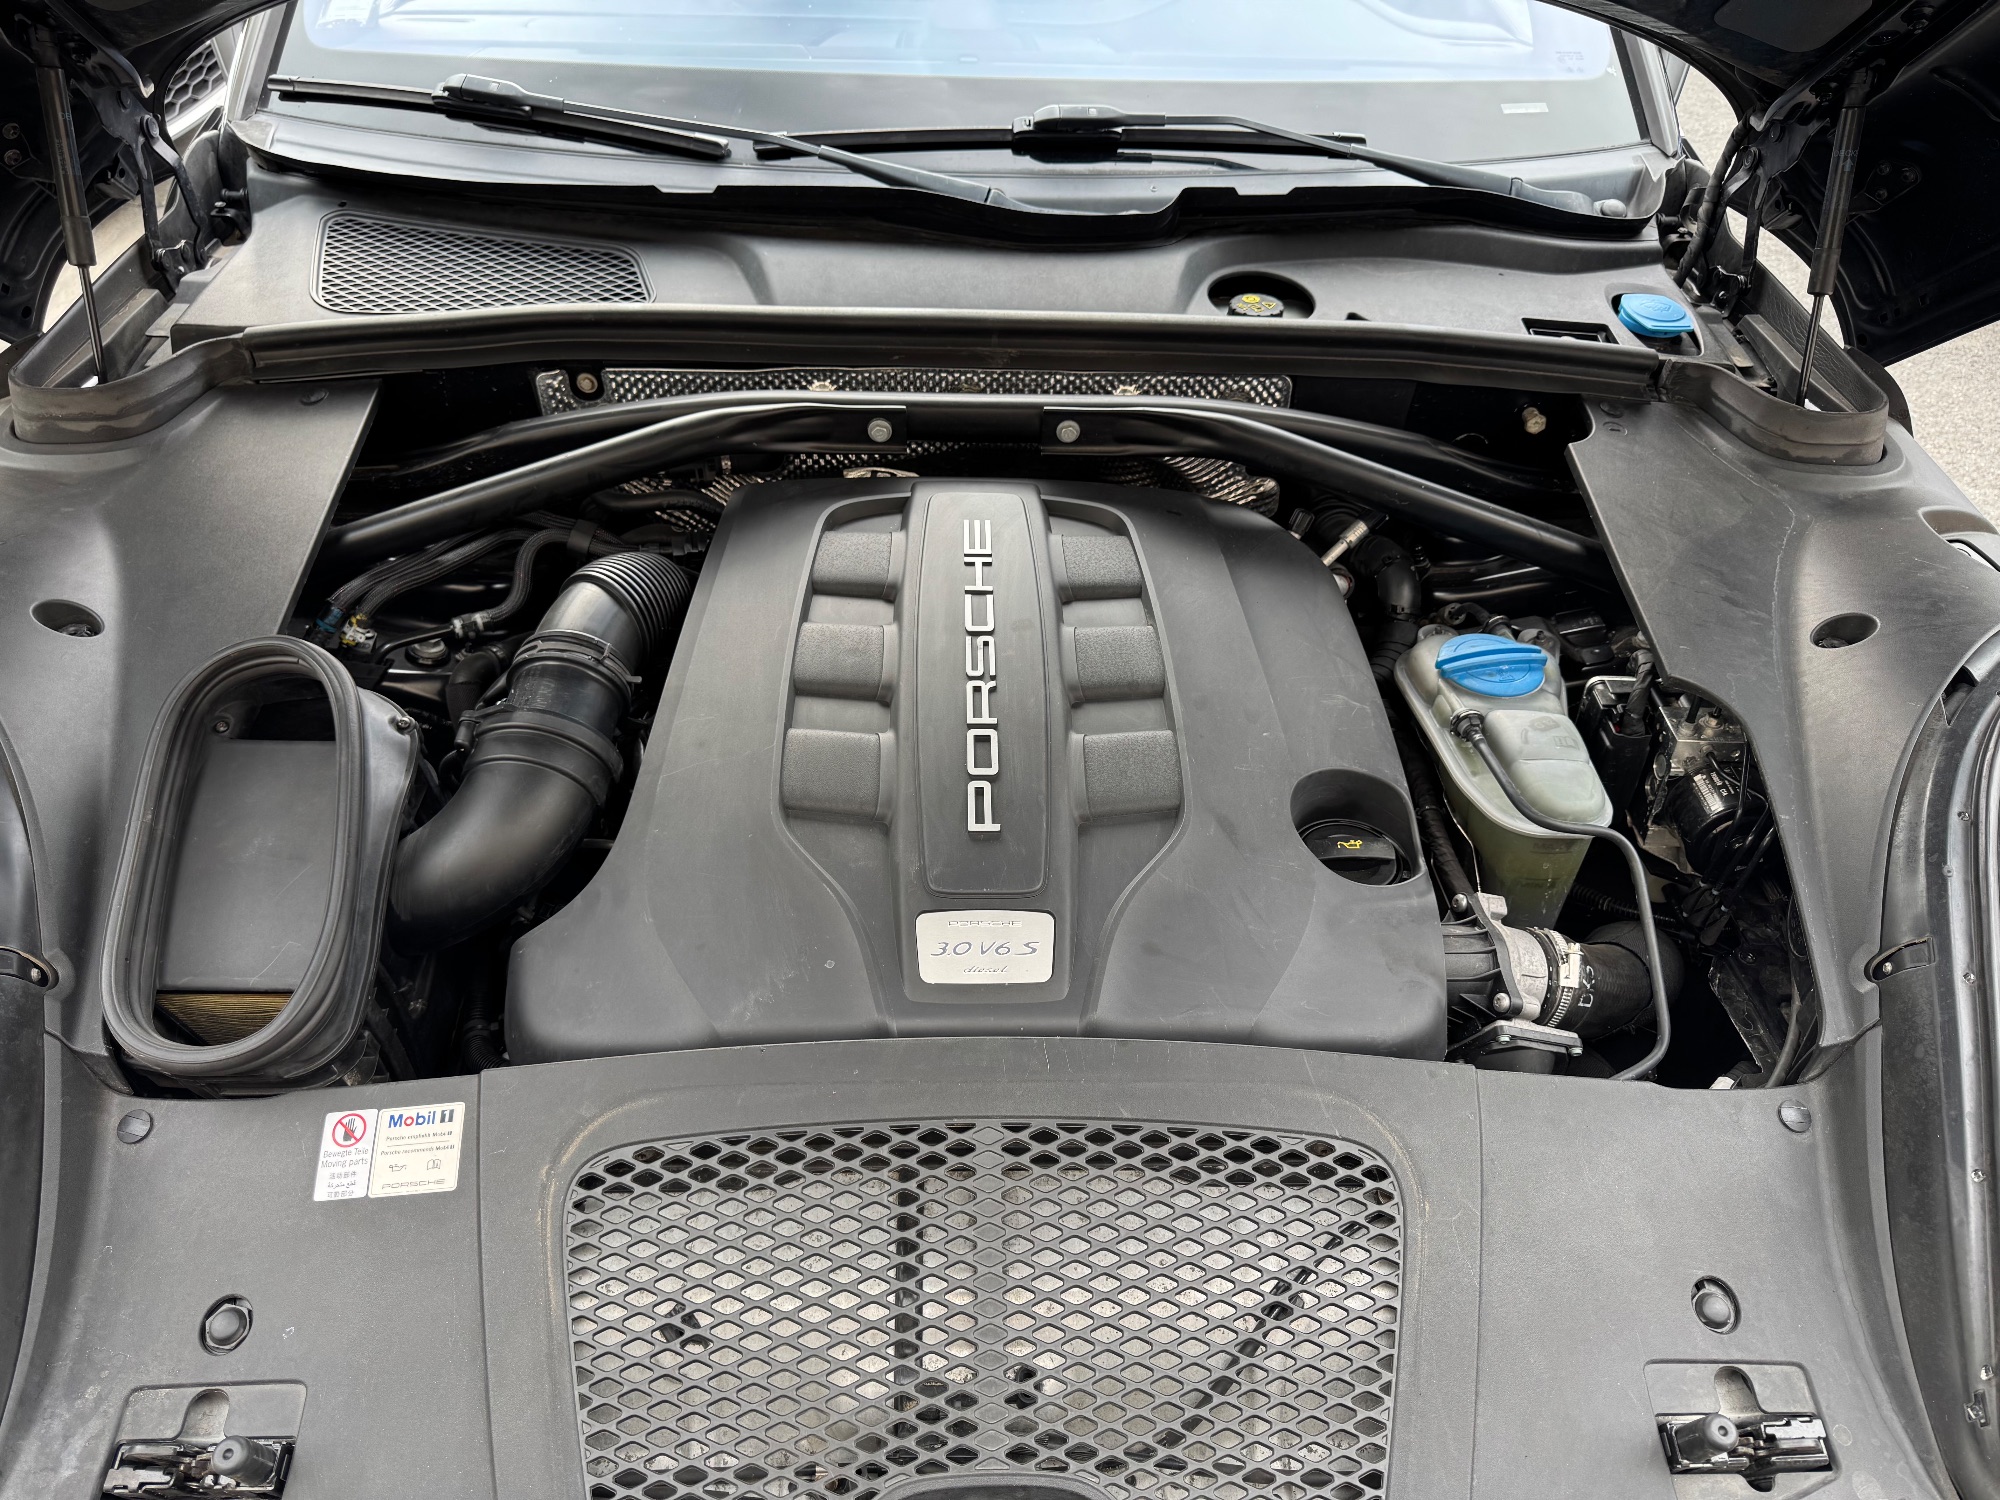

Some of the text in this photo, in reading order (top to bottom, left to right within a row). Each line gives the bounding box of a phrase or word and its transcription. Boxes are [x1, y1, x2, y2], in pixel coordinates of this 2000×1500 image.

[963, 519, 1001, 832] PORSCHE
[947, 920, 1023, 928] PORSCHE
[980, 941, 1011, 957] V6
[1014, 941, 1040, 956] S
[962, 965, 1009, 974] diesel
[388, 1109, 455, 1128] Mobil 1
[323, 1147, 369, 1159] Bewegte Teile
[321, 1157, 368, 1168] Moving parts
[381, 1178, 446, 1190] PORSCHE
